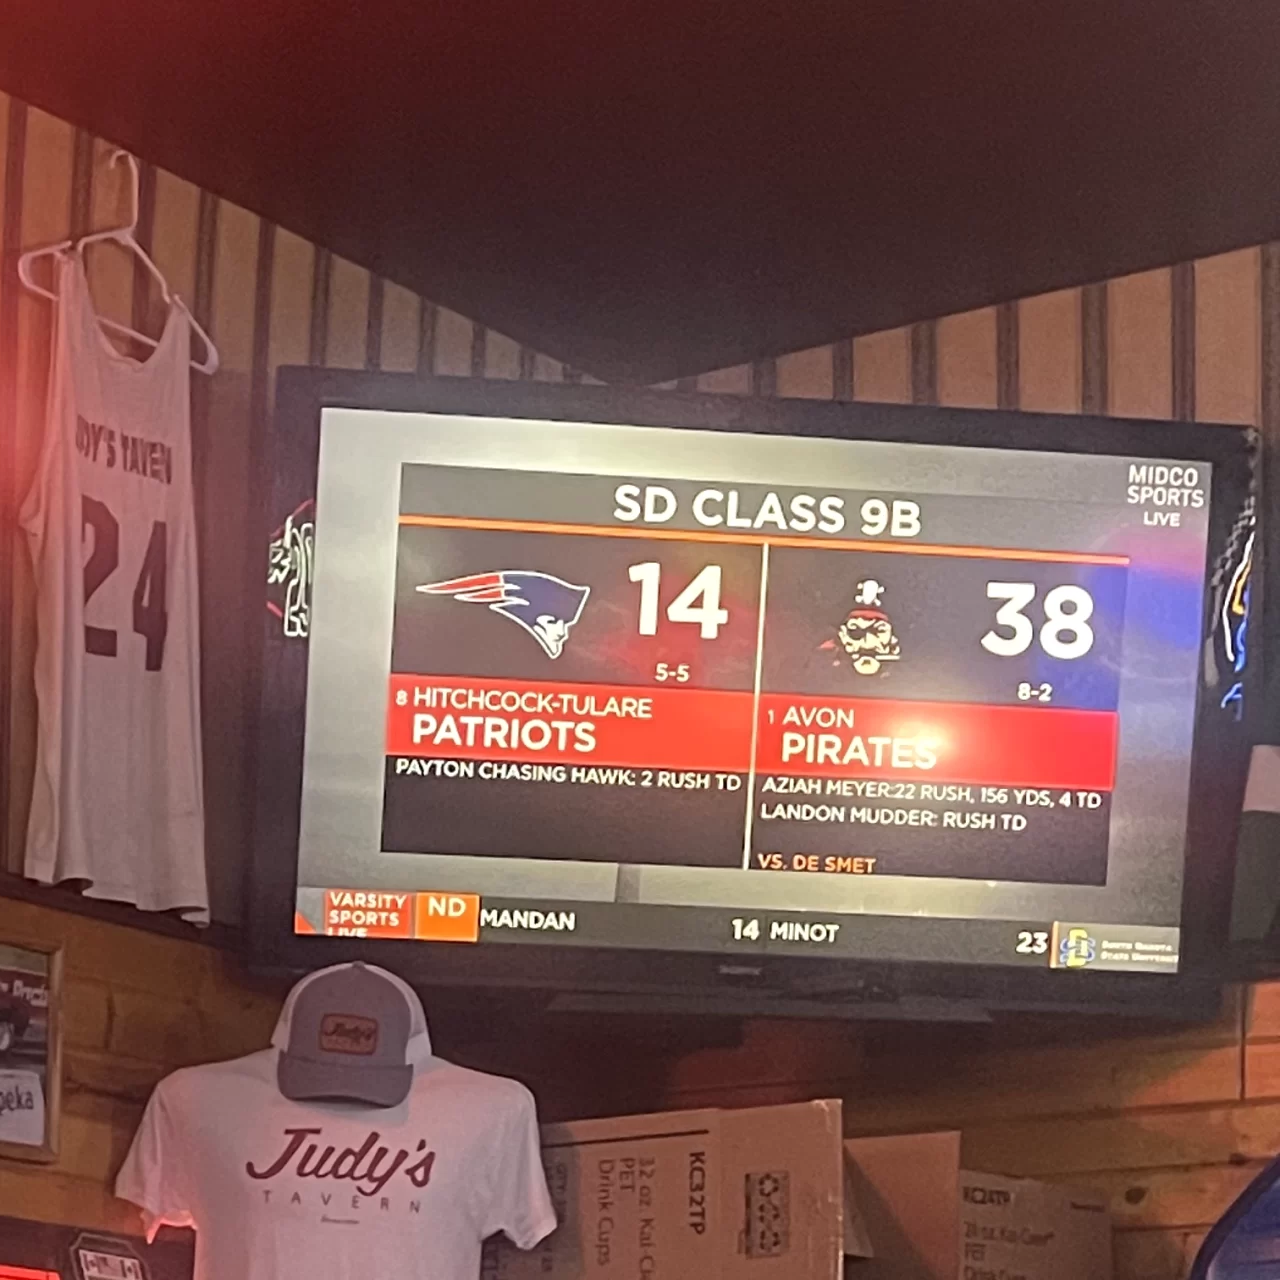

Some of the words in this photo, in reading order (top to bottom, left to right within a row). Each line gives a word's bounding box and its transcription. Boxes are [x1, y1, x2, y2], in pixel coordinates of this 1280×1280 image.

[1128, 464, 1199, 488] MIDCO
[1126, 485, 1205, 508] SPORTS
[613, 484, 677, 523] SD
[691, 487, 846, 534] CLASS
[860, 497, 922, 538] 9B
[1142, 509, 1181, 528] LIVE
[81, 493, 169, 672] 24
[627, 560, 729, 640] 14
[980, 581, 1095, 660] 38
[654, 662, 690, 683] 5-5
[395, 689, 408, 707] 8
[413, 686, 654, 719] HITCHCOCK-TULARE
[1018, 682, 1053, 703] 8-2
[768, 709, 775, 725] 1
[782, 705, 855, 729] AVON
[412, 713, 597, 753] PATRIOTS
[781, 731, 938, 770] PIRATES
[395, 758, 475, 778] PAYTON
[478, 762, 567, 783] CHASING
[571, 767, 636, 786] HAWK:
[640, 770, 653, 787] 2
[657, 770, 710, 791] RUSH
[715, 773, 742, 791] TD
[762, 776, 822, 796] AZIAH
[920, 785, 975, 804] RUSH,
[980, 786, 1009, 804] 156
[1014, 789, 1055, 809] YDS,
[1058, 791, 1072, 808] 4
[1077, 791, 1103, 809] TD
[761, 803, 846, 824] LANDON
[849, 805, 938, 828] MUDDER:
[942, 811, 996, 831] RUSH
[1001, 813, 1027, 832] TD
[757, 853, 789, 870] VS.
[792, 854, 820, 872] DE
[824, 856, 877, 874] SMET
[329, 891, 407, 909] VARSITY
[428, 895, 467, 917] ND
[328, 910, 400, 927] SPORTS
[479, 907, 576, 931] MANDAN
[731, 918, 759, 940] 14
[769, 920, 840, 945] MINOT
[1015, 931, 1048, 954] 23
[245, 1127, 437, 1197] Judy's
[619, 1157, 635, 1193] PET
[638, 1156, 655, 1178] 32
[597, 1159, 615, 1212] Drink
[688, 1151, 706, 1236] KC32TP
[263, 1188, 422, 1214] TAVERN
[594, 1216, 614, 1267] Cups
